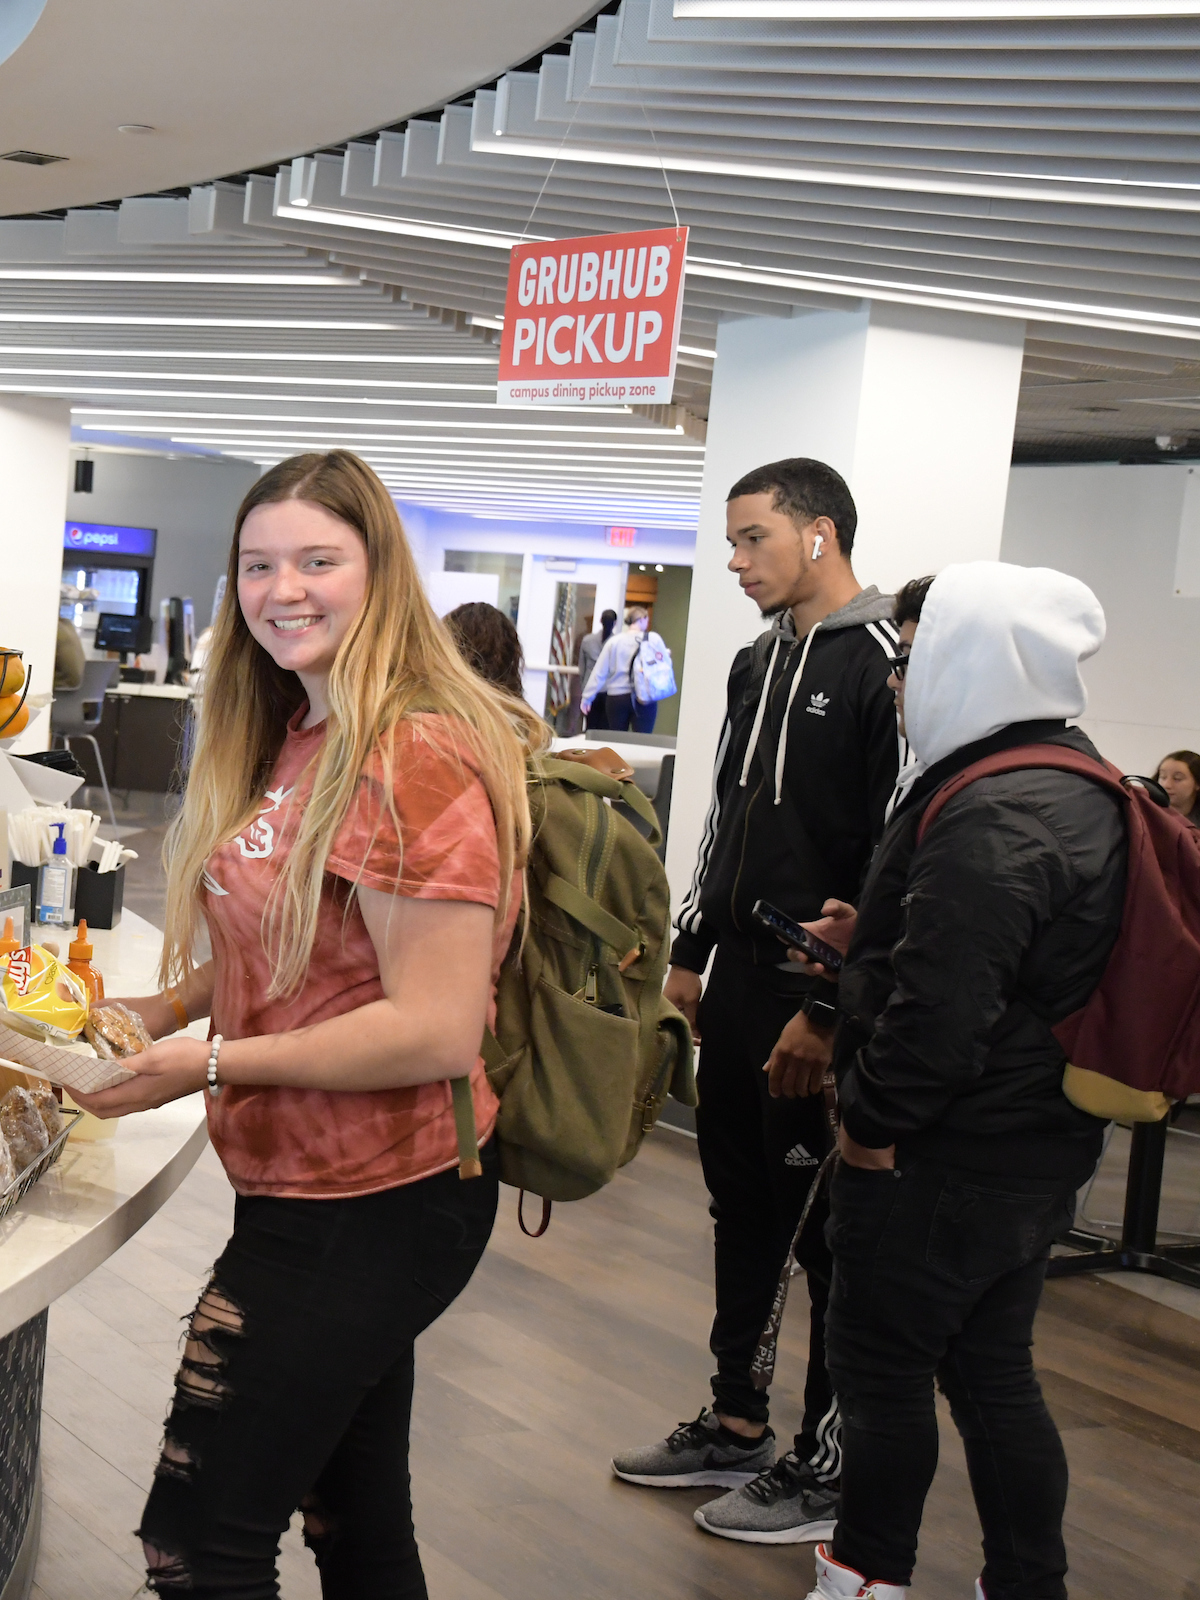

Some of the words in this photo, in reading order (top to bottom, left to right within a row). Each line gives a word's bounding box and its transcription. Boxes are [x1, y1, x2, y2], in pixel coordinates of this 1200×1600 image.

[518, 245, 670, 307] GRUBHUB
[512, 310, 662, 366] PICKUP
[509, 383, 550, 402] campus
[552, 379, 586, 400] dining
[589, 380, 626, 402] pickup
[629, 384, 656, 397] zone
[84, 532, 118, 546] pepsi
[806, 706, 826, 716] adidas
[784, 1157, 818, 1166] adidas
[764, 1282, 784, 1334] THETA
[752, 1346, 768, 1374] PHI
